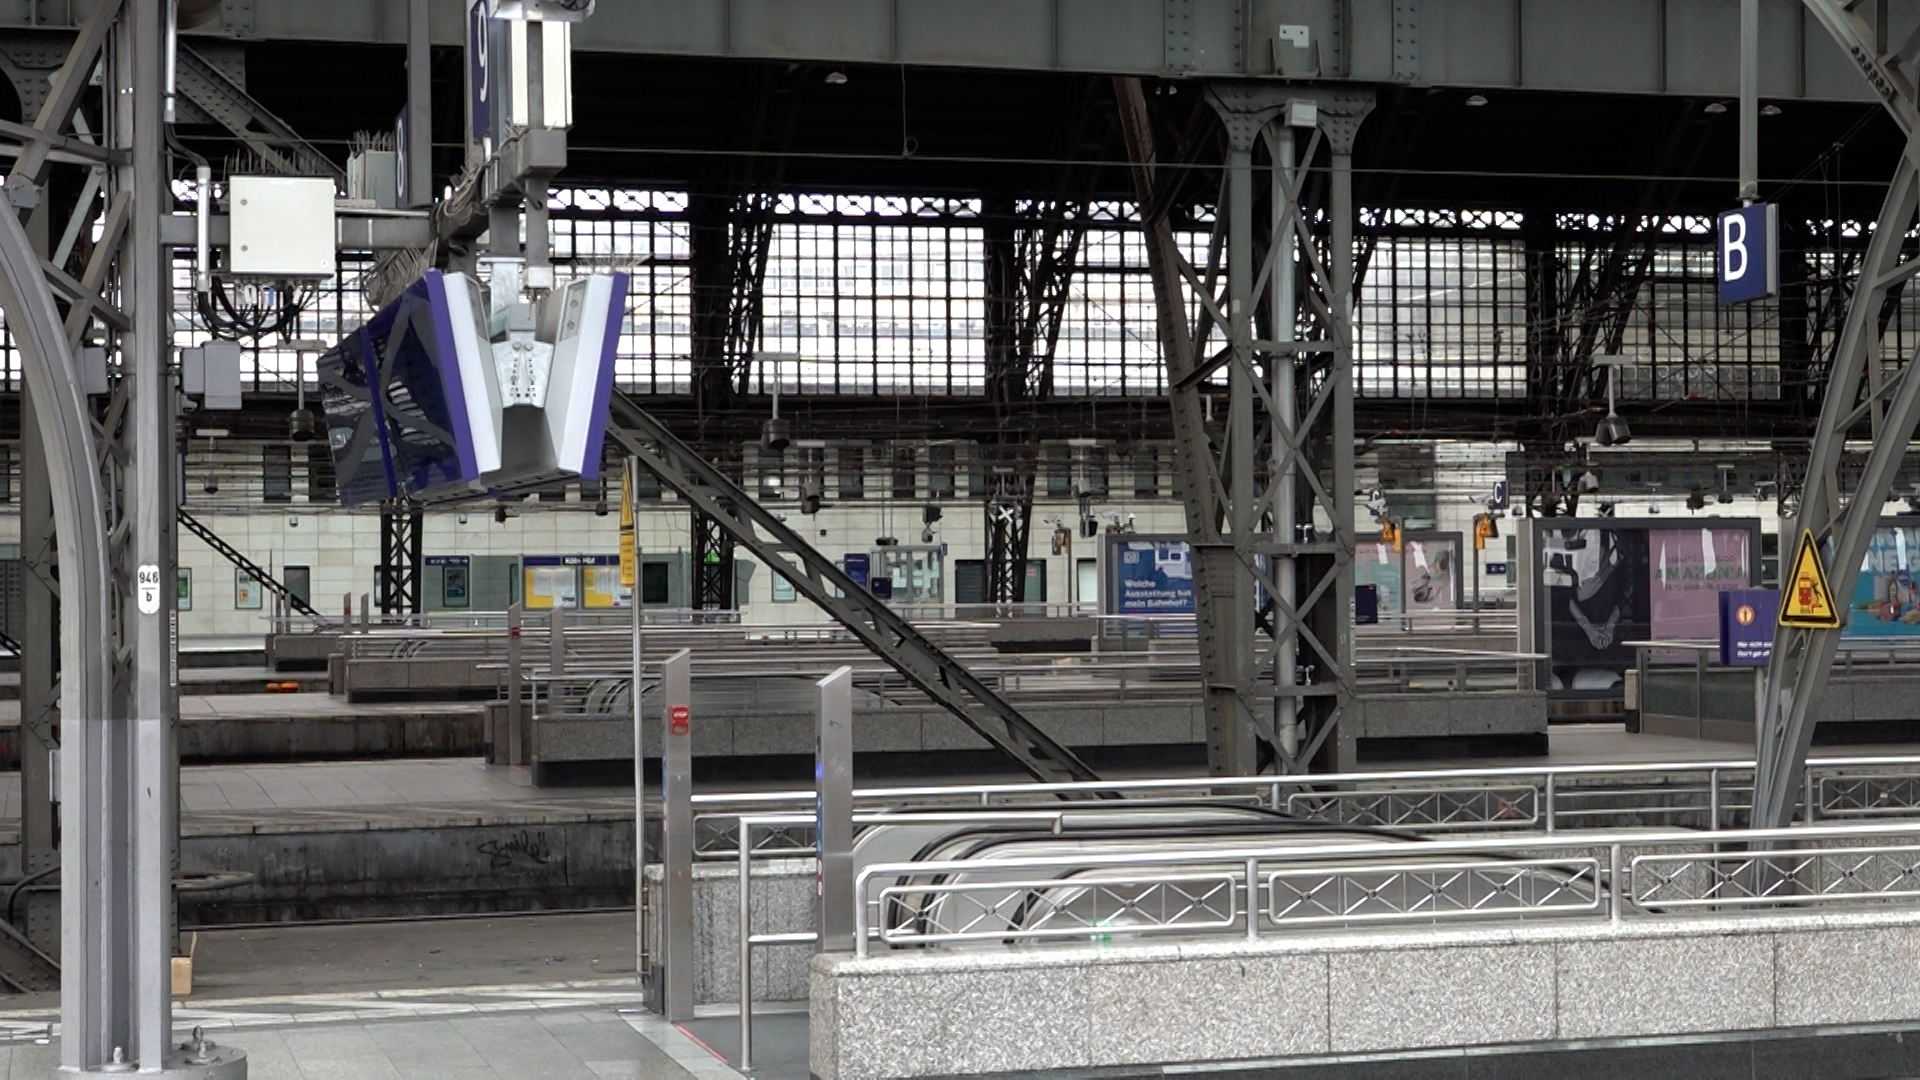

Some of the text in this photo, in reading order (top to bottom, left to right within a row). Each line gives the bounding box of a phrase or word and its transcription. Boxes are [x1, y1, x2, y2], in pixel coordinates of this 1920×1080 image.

[477, 1, 488, 103] 9
[396, 117, 404, 198] 8
[1723, 213, 1748, 282] B
[1494, 483, 1502, 504] C
[146, 591, 152, 602] b
